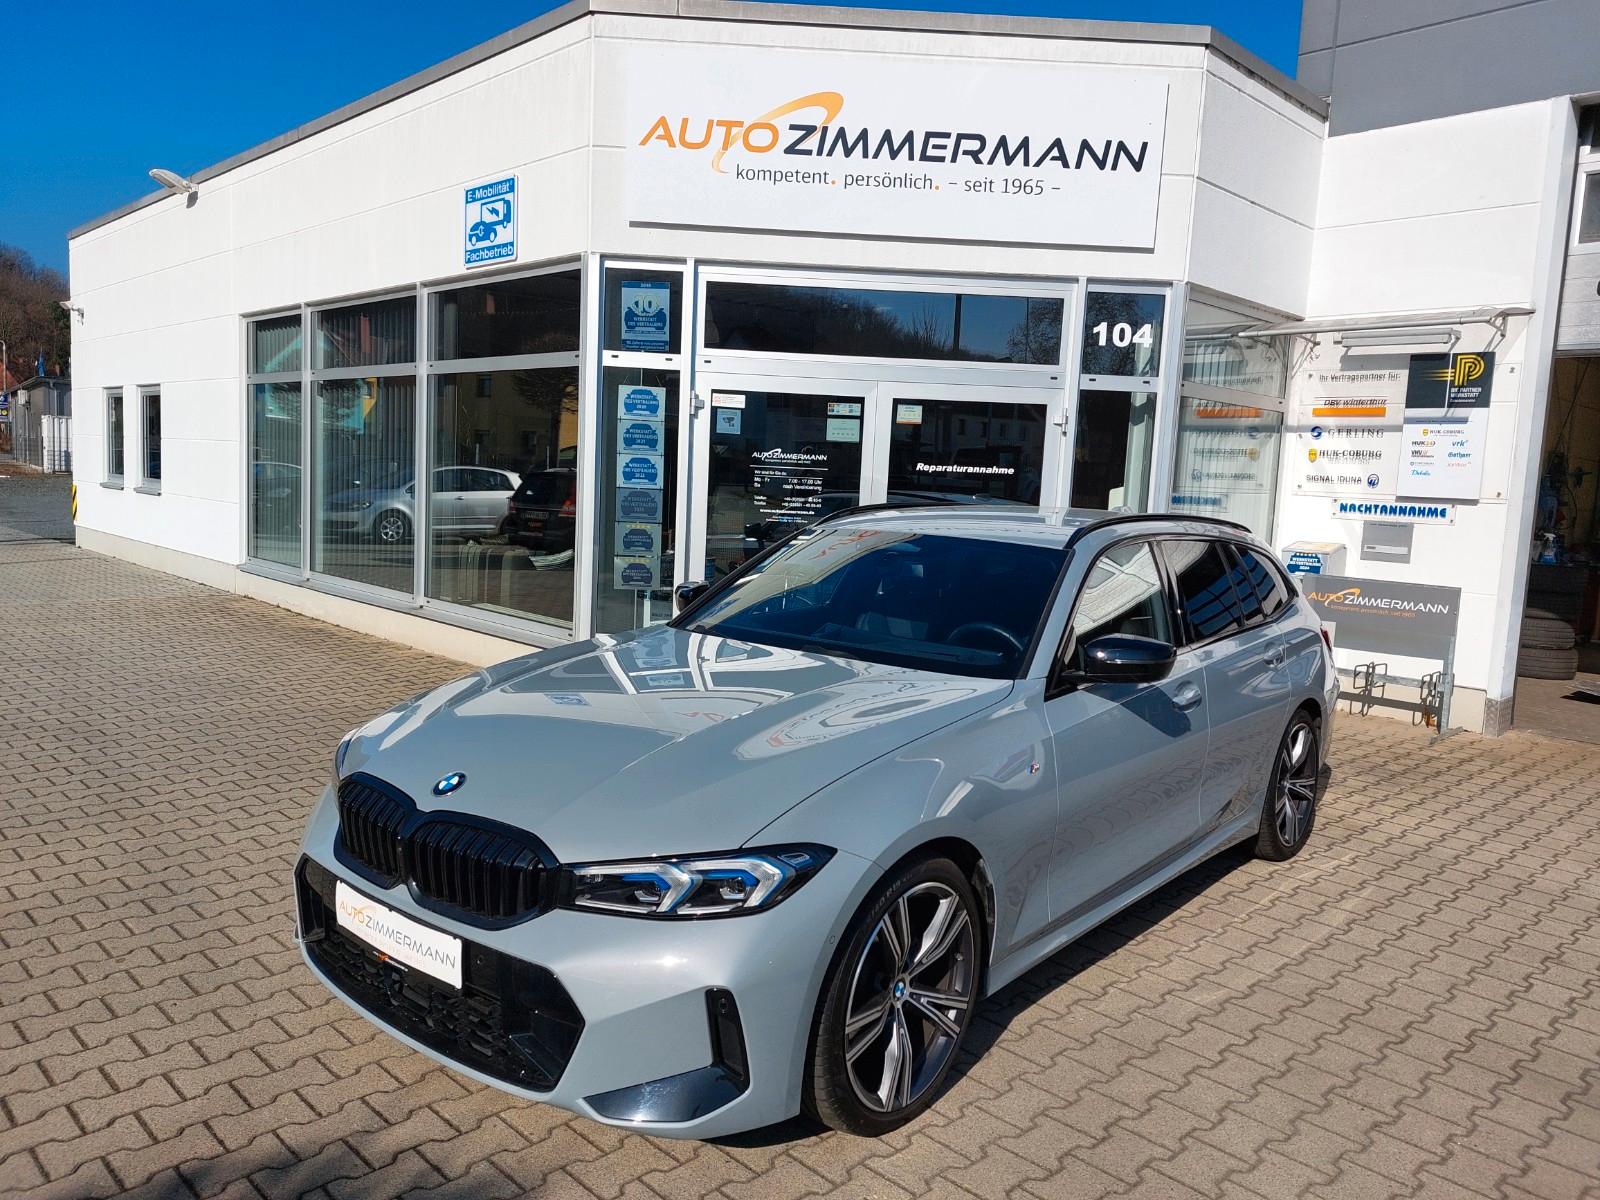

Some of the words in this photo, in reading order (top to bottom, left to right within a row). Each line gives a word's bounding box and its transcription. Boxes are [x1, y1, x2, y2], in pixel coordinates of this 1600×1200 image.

[736, 163, 836, 186] kompetent.
[844, 172, 940, 191] persönlich.
[964, 176, 995, 193] seit
[1001, 178, 1045, 195] 1965
[465, 244, 514, 262] Fachbetrieb
[1092, 321, 1153, 348] 104
[1330, 373, 1386, 383] Vertragspartner
[1327, 428, 1384, 437] GERLING
[1319, 449, 1382, 458] HUK-COBURG
[915, 462, 1015, 475] Reparaturannahme
[1306, 474, 1334, 482] SIGNAL
[1339, 502, 1447, 518] NACHTANNAHME
[365, 915, 456, 969] ZIMMERMANN
